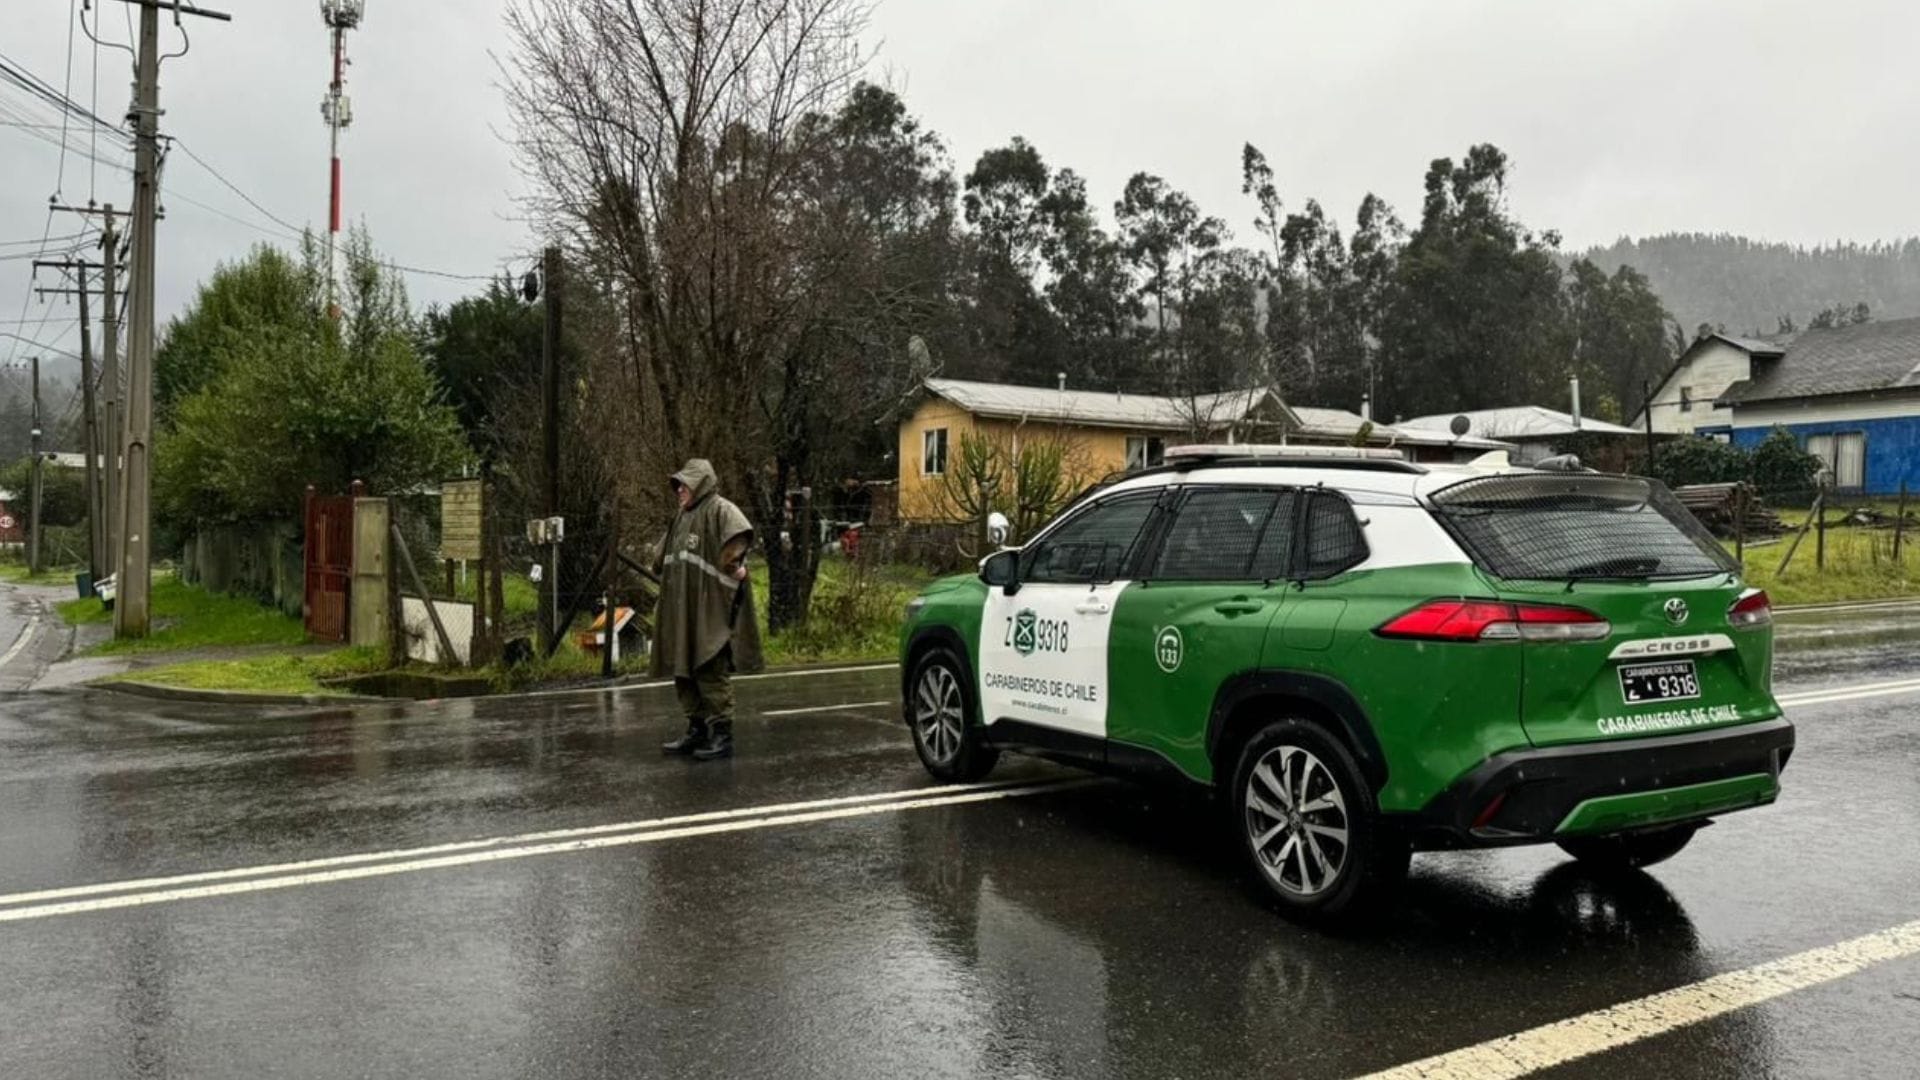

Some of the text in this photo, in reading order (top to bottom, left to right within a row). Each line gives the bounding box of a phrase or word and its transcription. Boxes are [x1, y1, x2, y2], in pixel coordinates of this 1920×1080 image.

[1005, 616, 1069, 653] Z 9318
[1646, 640, 1710, 653] CROSS
[1161, 648, 1177, 664] 133
[985, 672, 1097, 702] CARABINEROS DE CHILE
[1597, 704, 1741, 734] CARABINEROS DE CHILE
